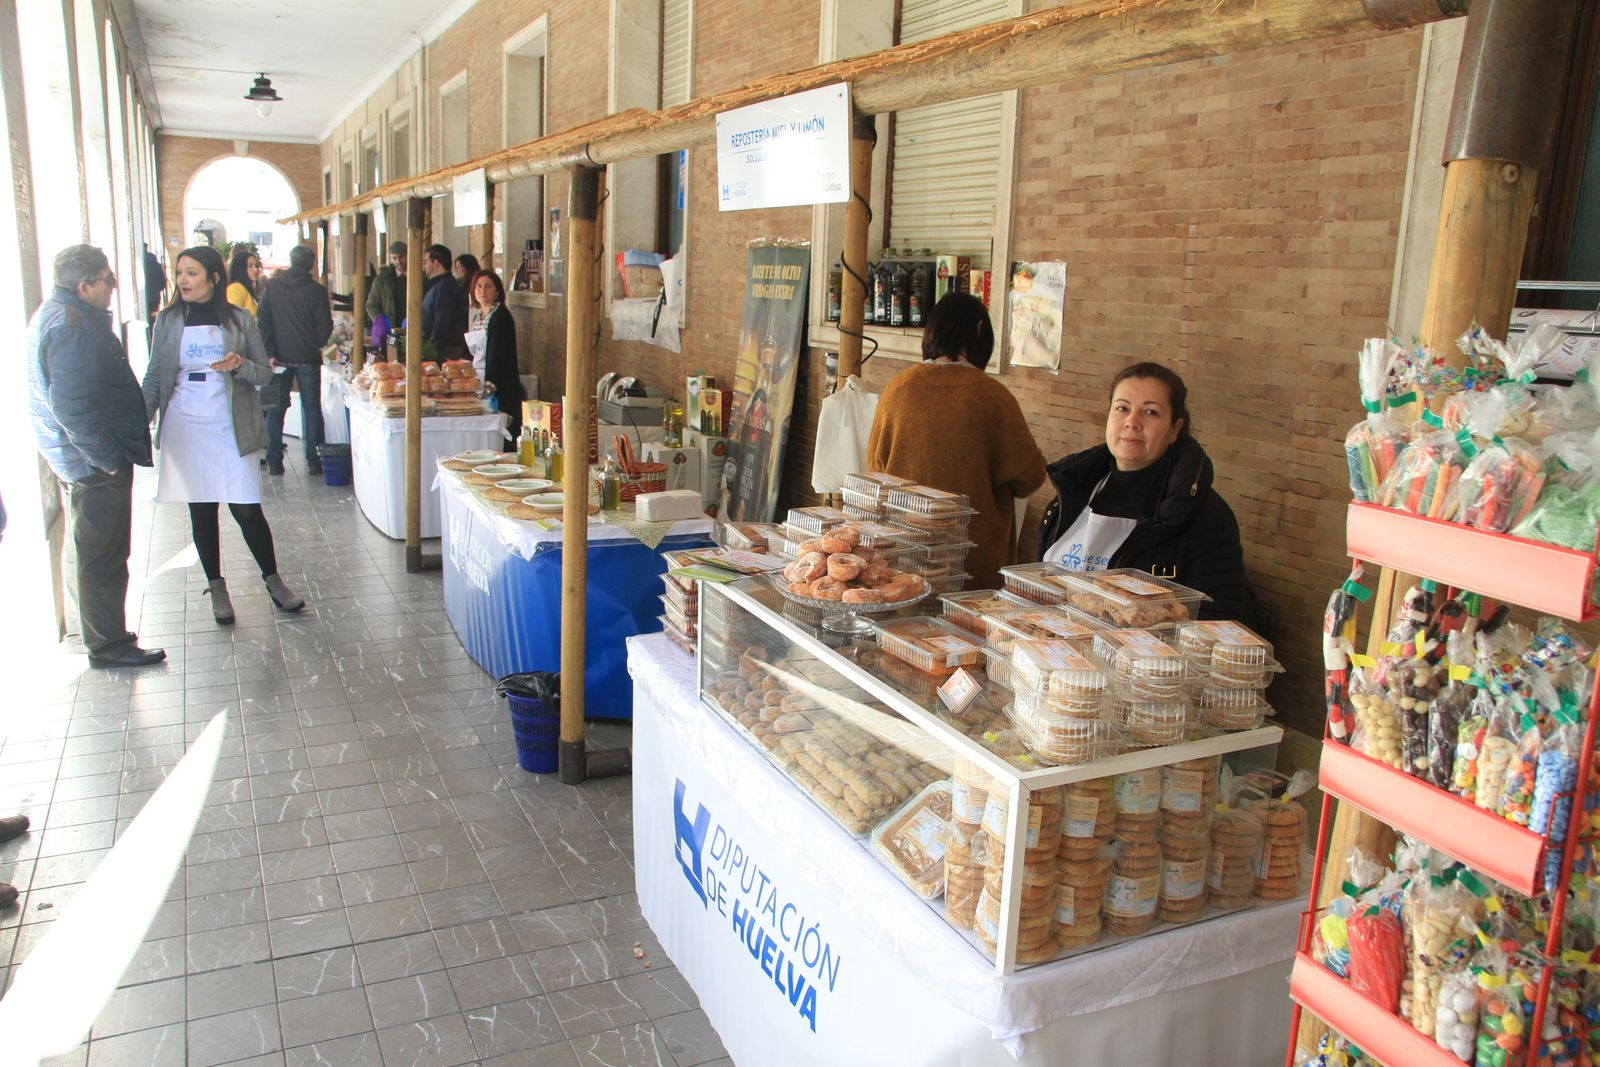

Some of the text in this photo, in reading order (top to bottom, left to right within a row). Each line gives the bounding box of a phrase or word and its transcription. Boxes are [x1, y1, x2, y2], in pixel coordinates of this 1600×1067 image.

[731, 125, 770, 148] REPOSTERÍA
[752, 265, 774, 279] ACEITE
[782, 265, 801, 280] OLIVA
[706, 866, 817, 1034] DE HUELVA
[710, 824, 841, 993] DIPUTACIÓN
